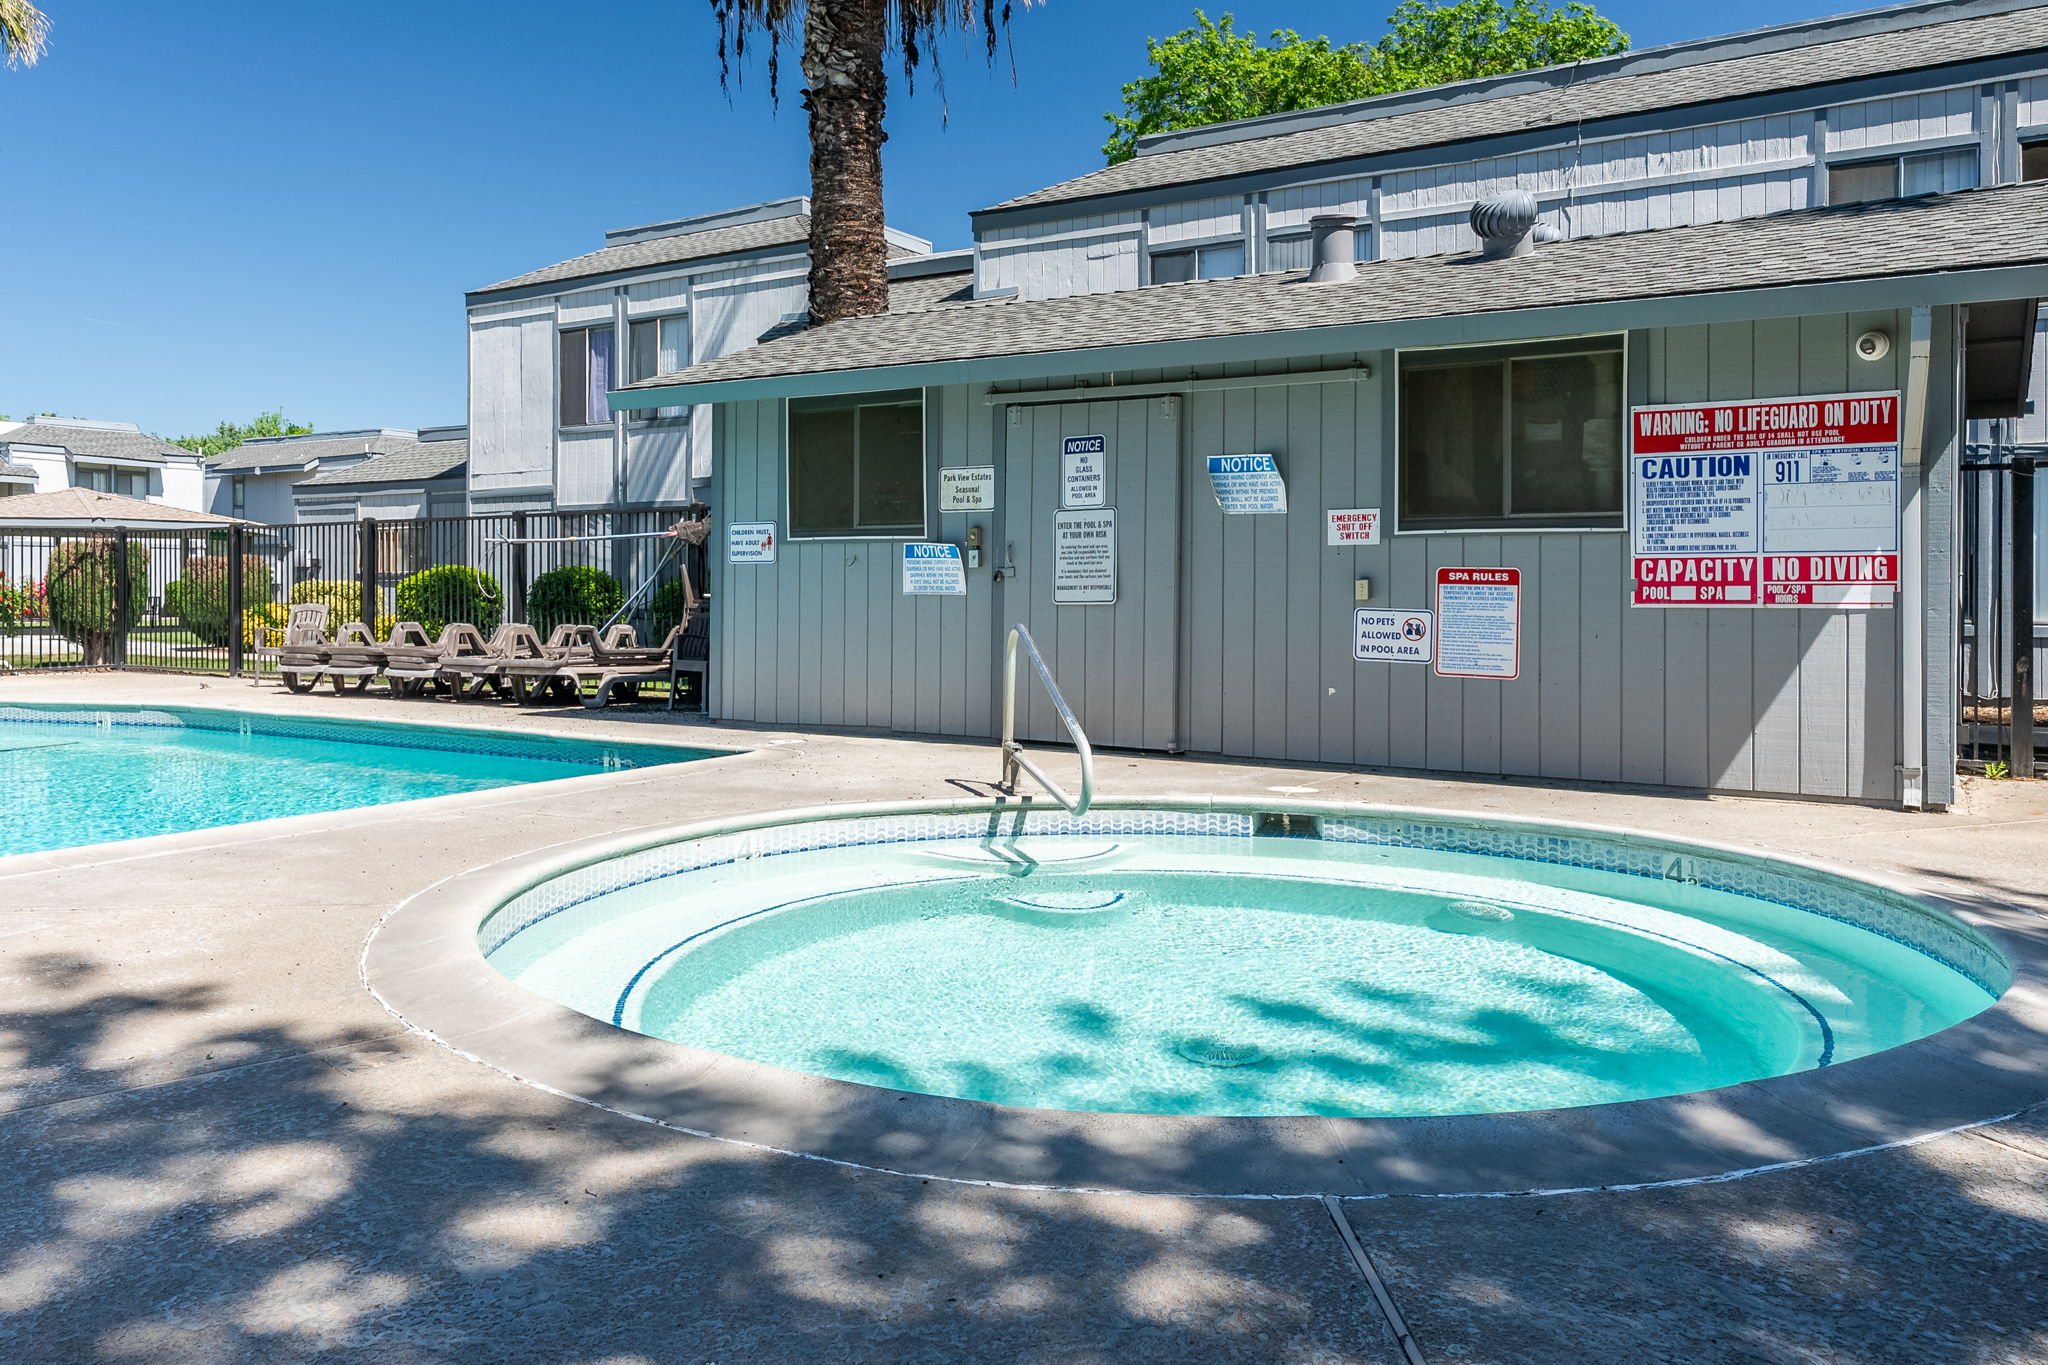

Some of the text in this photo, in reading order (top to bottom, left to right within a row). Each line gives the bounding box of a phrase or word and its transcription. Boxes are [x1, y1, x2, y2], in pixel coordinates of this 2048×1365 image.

[1640, 400, 1891, 436] WARNING: NO LIFEGUARD ON DUTY
[1068, 440, 1101, 452] NOTICE
[1680, 442, 1705, 450] WITHOUT
[1806, 436, 1845, 444] ATTENDANCE
[1772, 452, 1796, 460] EMERGENCY
[1221, 457, 1271, 472] NOTICE
[1642, 455, 1750, 479] CAUTION
[1776, 461, 1800, 482] 911
[944, 474, 956, 482] Park
[972, 473, 992, 481] Estates
[1068, 474, 1101, 482] CONTAINERS
[956, 485, 980, 493] Seasonal
[972, 496, 982, 504] Spa
[1332, 514, 1377, 523] EMERGENCY
[1058, 522, 1072, 530] ENTER
[1337, 523, 1355, 531] SHUT
[1340, 532, 1370, 540] SWITCH
[914, 545, 952, 558] NOTICE
[1641, 559, 1754, 582] CAPACITY
[1772, 557, 1888, 580] NO DIVING
[1449, 572, 1509, 581] SPA RULES
[1643, 586, 1723, 600] POOL SPA
[1768, 585, 1806, 594] POOL/SPA
[1776, 595, 1798, 603] HOURS
[1362, 617, 1395, 626] NO PETS
[1362, 631, 1401, 640] ALLOWED
[1372, 646, 1394, 654] POOL
[1397, 647, 1420, 655] AREA
[608, 750, 615, 766] 8
[1665, 857, 1686, 883] 4
